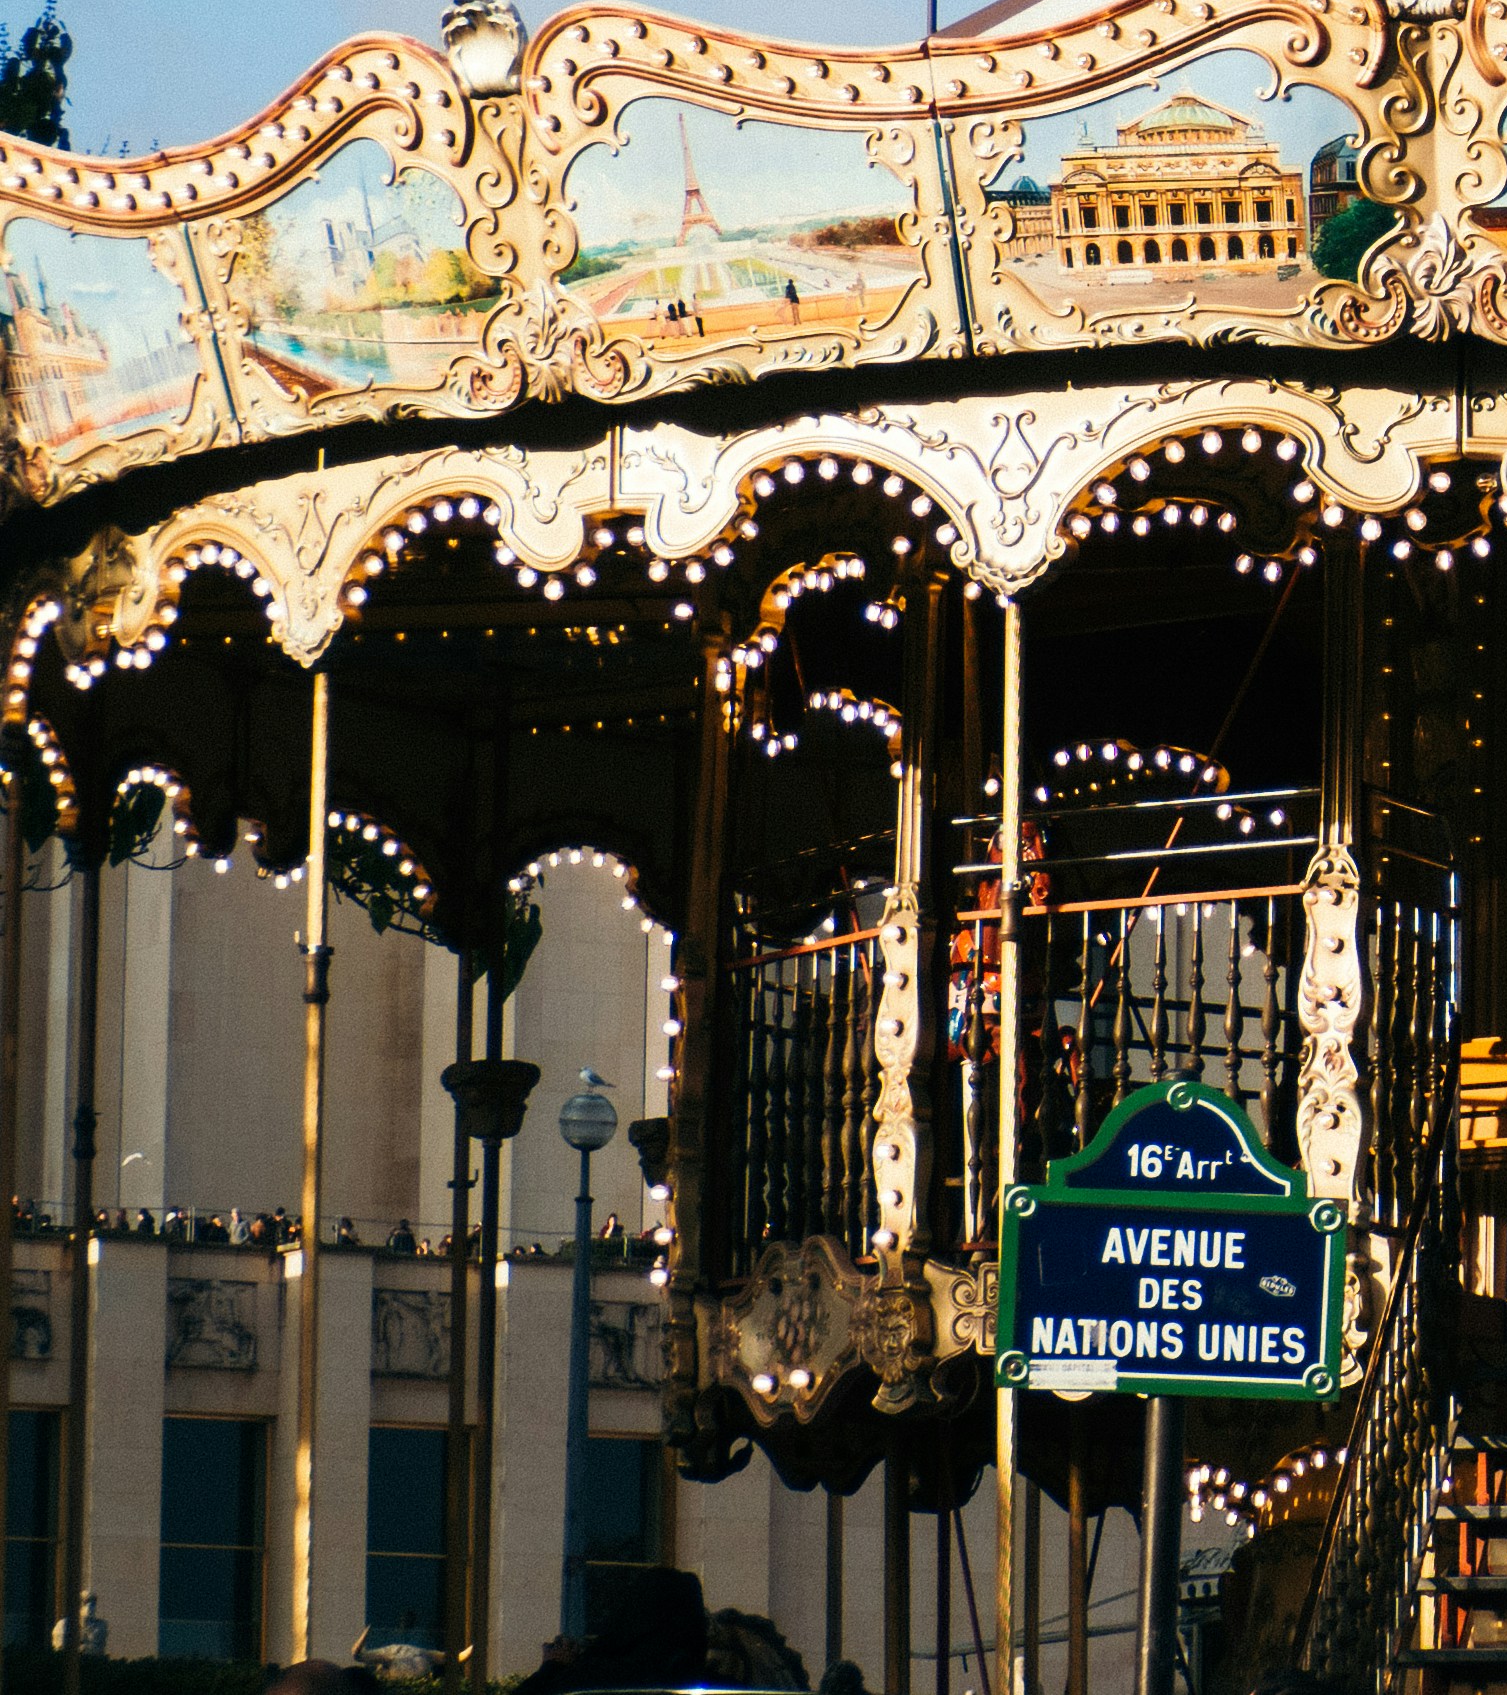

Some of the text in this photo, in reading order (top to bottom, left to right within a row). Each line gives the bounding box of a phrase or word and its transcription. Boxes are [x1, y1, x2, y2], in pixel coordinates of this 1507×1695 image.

[1101, 1227, 1246, 1270] AVENUE
[1138, 1277, 1203, 1311] DES
[1031, 1317, 1306, 1365] NATIONS UNIES
